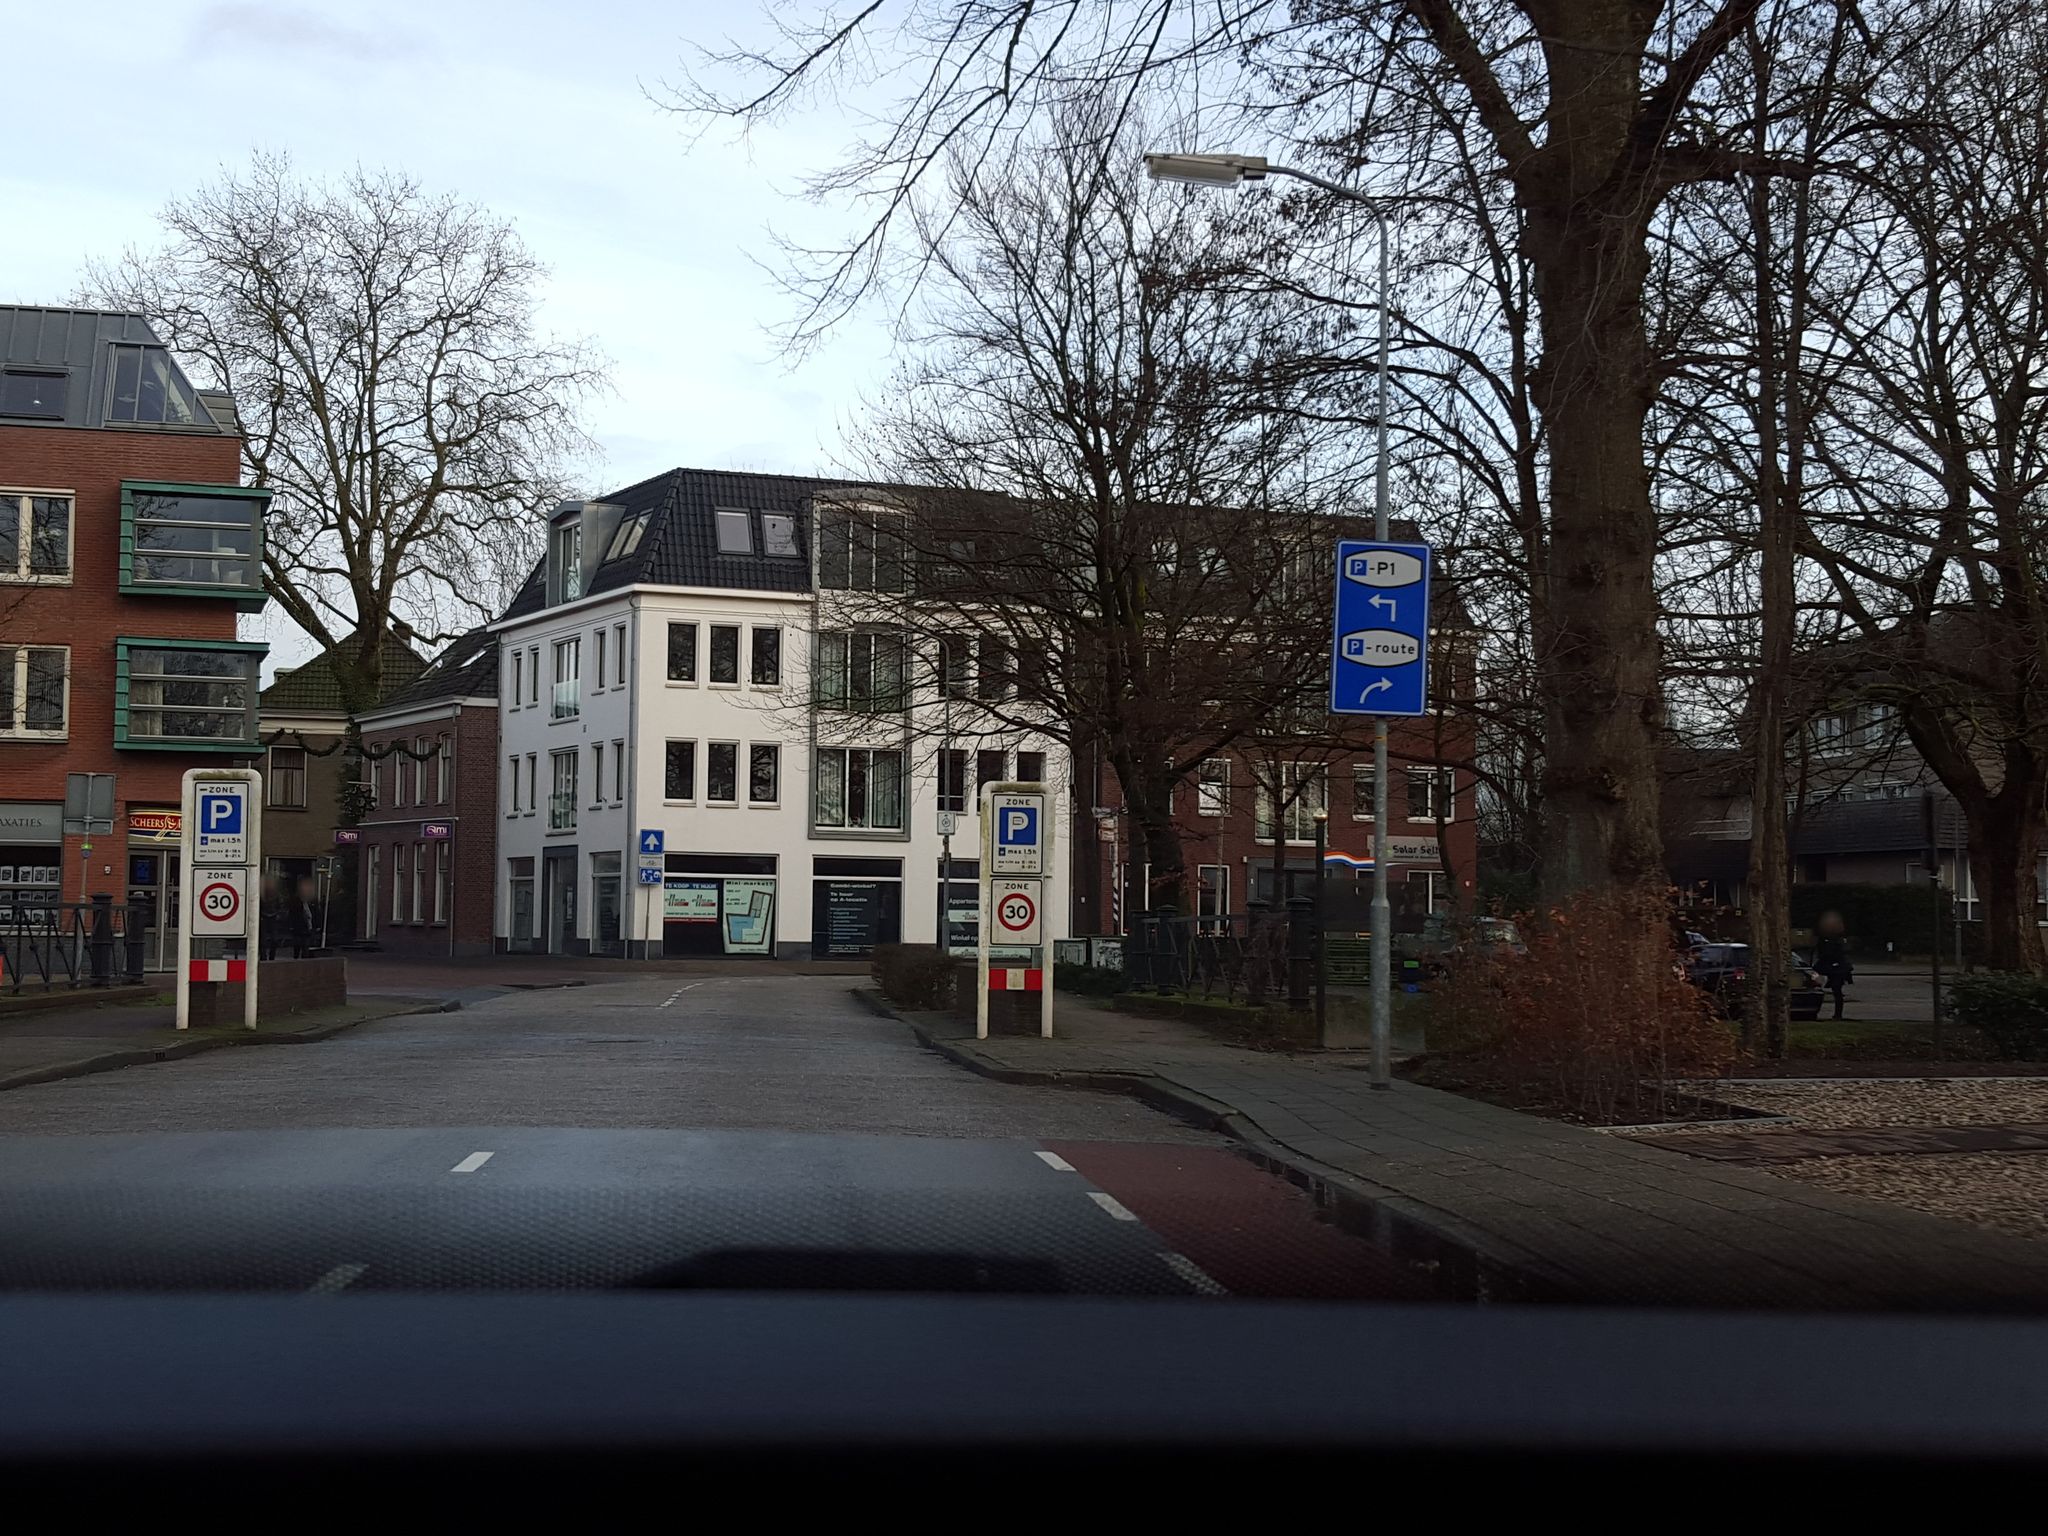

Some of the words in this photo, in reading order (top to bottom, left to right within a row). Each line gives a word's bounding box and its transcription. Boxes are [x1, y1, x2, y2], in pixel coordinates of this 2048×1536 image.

[130, 816, 165, 828] SCHEERS
[210, 799, 233, 830] P
[1007, 811, 1029, 841] P
[1392, 845, 1417, 854] Solar
[207, 872, 233, 880] ZONE
[206, 894, 232, 910] 30
[1004, 904, 1028, 920] 30
